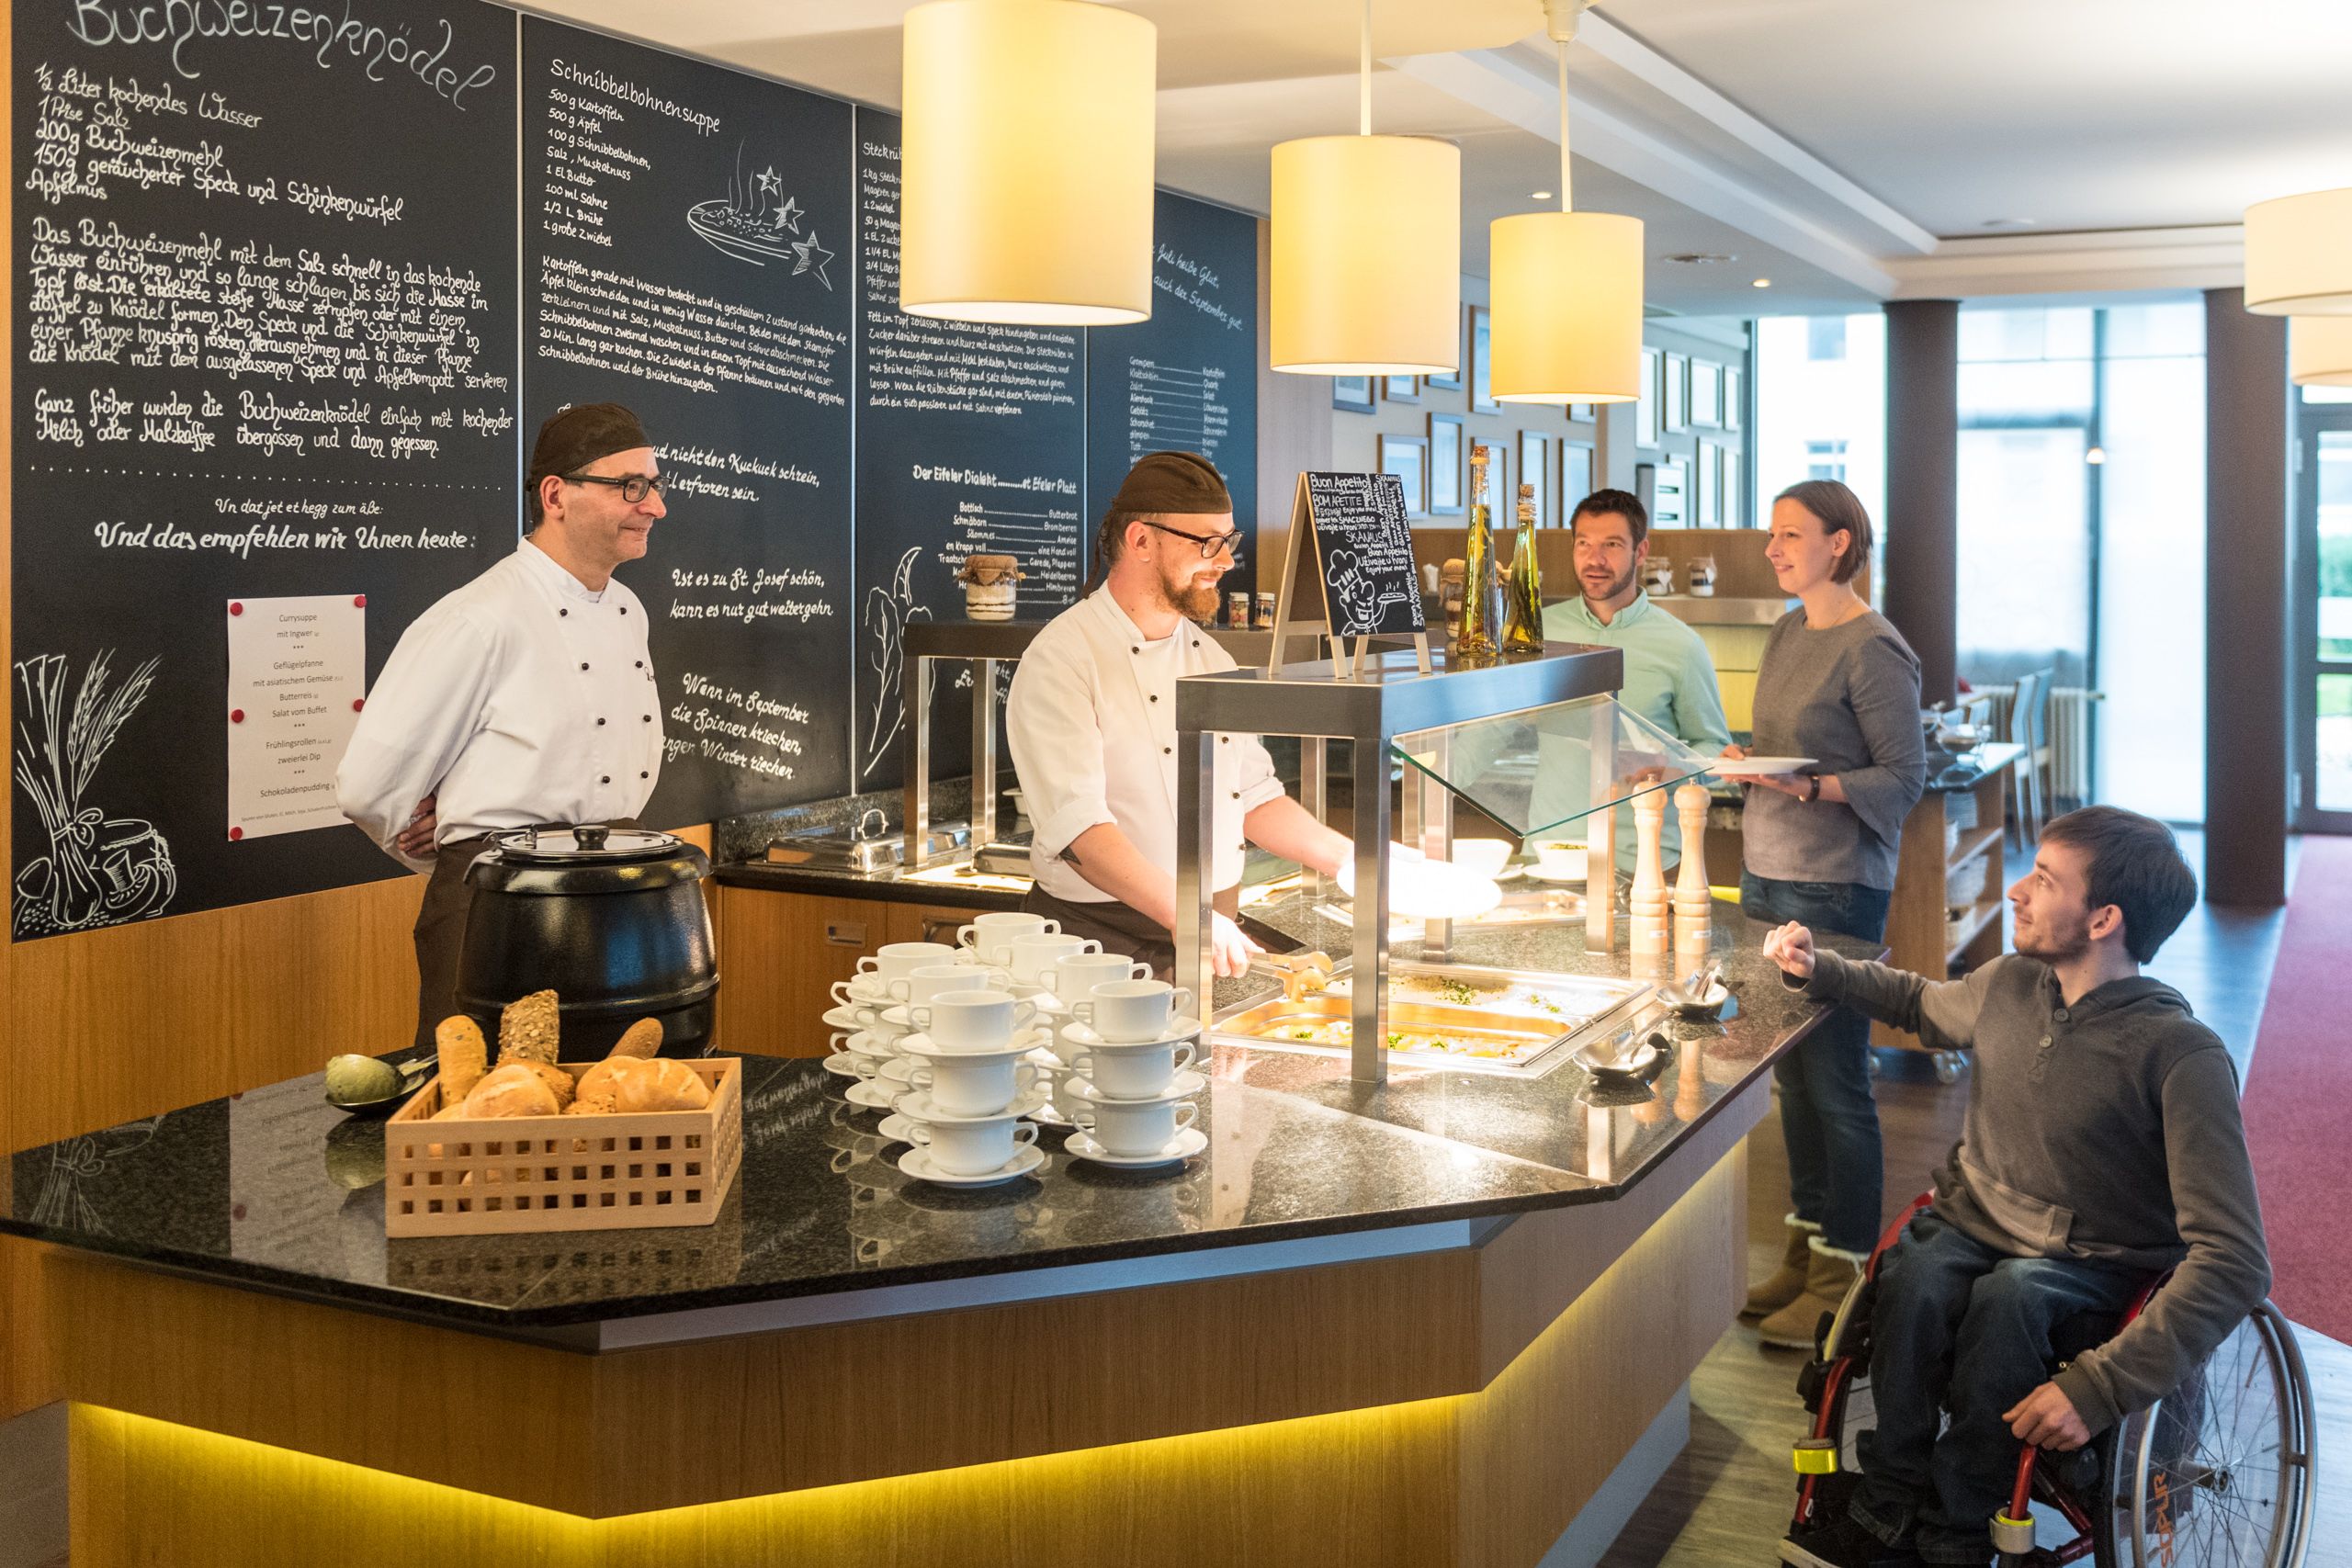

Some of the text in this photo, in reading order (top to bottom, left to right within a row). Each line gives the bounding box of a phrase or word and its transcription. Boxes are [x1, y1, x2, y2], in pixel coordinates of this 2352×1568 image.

[65, 0, 496, 111] Buchweizenknödel
[58, 67, 102, 99] Liter
[108, 75, 188, 116] kochendes
[198, 92, 263, 128] Wasser
[548, 88, 625, 121] 500 g Kartoffeln
[550, 59, 721, 137] Schnibbelbohnensuppe
[92, 103, 131, 130] Salz
[548, 107, 603, 135] 500 g Äpfel
[85, 124, 224, 178] Buchweizenmehl
[548, 128, 651, 171] 100 g Schnibbelbohnen,
[546, 164, 552, 175] 1
[566, 168, 596, 186] Butter
[576, 153, 632, 181] Muskatnuss
[26, 167, 107, 204] Apfelmus
[86, 158, 186, 190] geräucherter
[194, 167, 242, 199] Speck
[247, 176, 279, 205] und
[287, 181, 404, 228] Schinkenwürfel
[545, 183, 608, 210] 100 ml Sahne
[543, 200, 561, 214] 1/2
[577, 209, 604, 227] Brühe
[543, 220, 613, 247] 1 große Zwiebel
[32, 217, 481, 295] Das Buchweizenmehl mit dem Salz schnell in das kochende
[1153, 276, 1173, 292] auch
[1188, 290, 1228, 322] September
[35, 388, 514, 437] Ganz früher wurden die Buchweizenknödel einfach mit kochender
[36, 416, 440, 459] Milch oder Malzkaffee übergossen und dann gegessen.
[670, 445, 824, 488] nicht den Kuckuck schrein,
[912, 464, 933, 480] Der
[933, 466, 963, 483] Eifeler
[1032, 476, 1056, 492] Efeler
[1057, 478, 1077, 494] Platt
[679, 474, 729, 499] erfroren
[731, 486, 760, 502] sein.
[1309, 473, 1368, 489] Buon Appetito
[331, 503, 357, 514] zum
[94, 521, 153, 548] Und
[153, 522, 198, 550] das
[199, 524, 310, 560] empfehlen
[313, 526, 348, 549] wir
[354, 525, 414, 549] Ihnen
[1345, 530, 1385, 543] SKANAUS
[673, 568, 694, 587] Ist
[695, 572, 710, 586] es
[712, 573, 728, 586] zu
[752, 568, 790, 594] Josef
[789, 569, 825, 588] schön,
[278, 614, 318, 623] Currysuppe
[670, 598, 704, 619] kann
[706, 604, 719, 618] es
[721, 603, 745, 617] nur
[743, 601, 769, 625] gut
[289, 629, 313, 639] Ingwer
[273, 660, 324, 671] Geflügelpfanne
[253, 680, 266, 688] mit
[266, 675, 305, 687] asiatischem
[306, 674, 334, 683] Gemüse
[279, 692, 312, 702] Butterreis
[683, 672, 723, 701] Wenn
[726, 687, 743, 707] im
[745, 691, 809, 724] September
[272, 709, 290, 718] Salat
[307, 705, 328, 715] Buffet
[671, 702, 802, 756] die Spinnen kriechen,
[266, 738, 317, 750] Frühlingsrollen
[277, 752, 322, 764] zweierlei Dip
[700, 739, 748, 768] Winter
[260, 782, 331, 798] Schokoladenpudding
